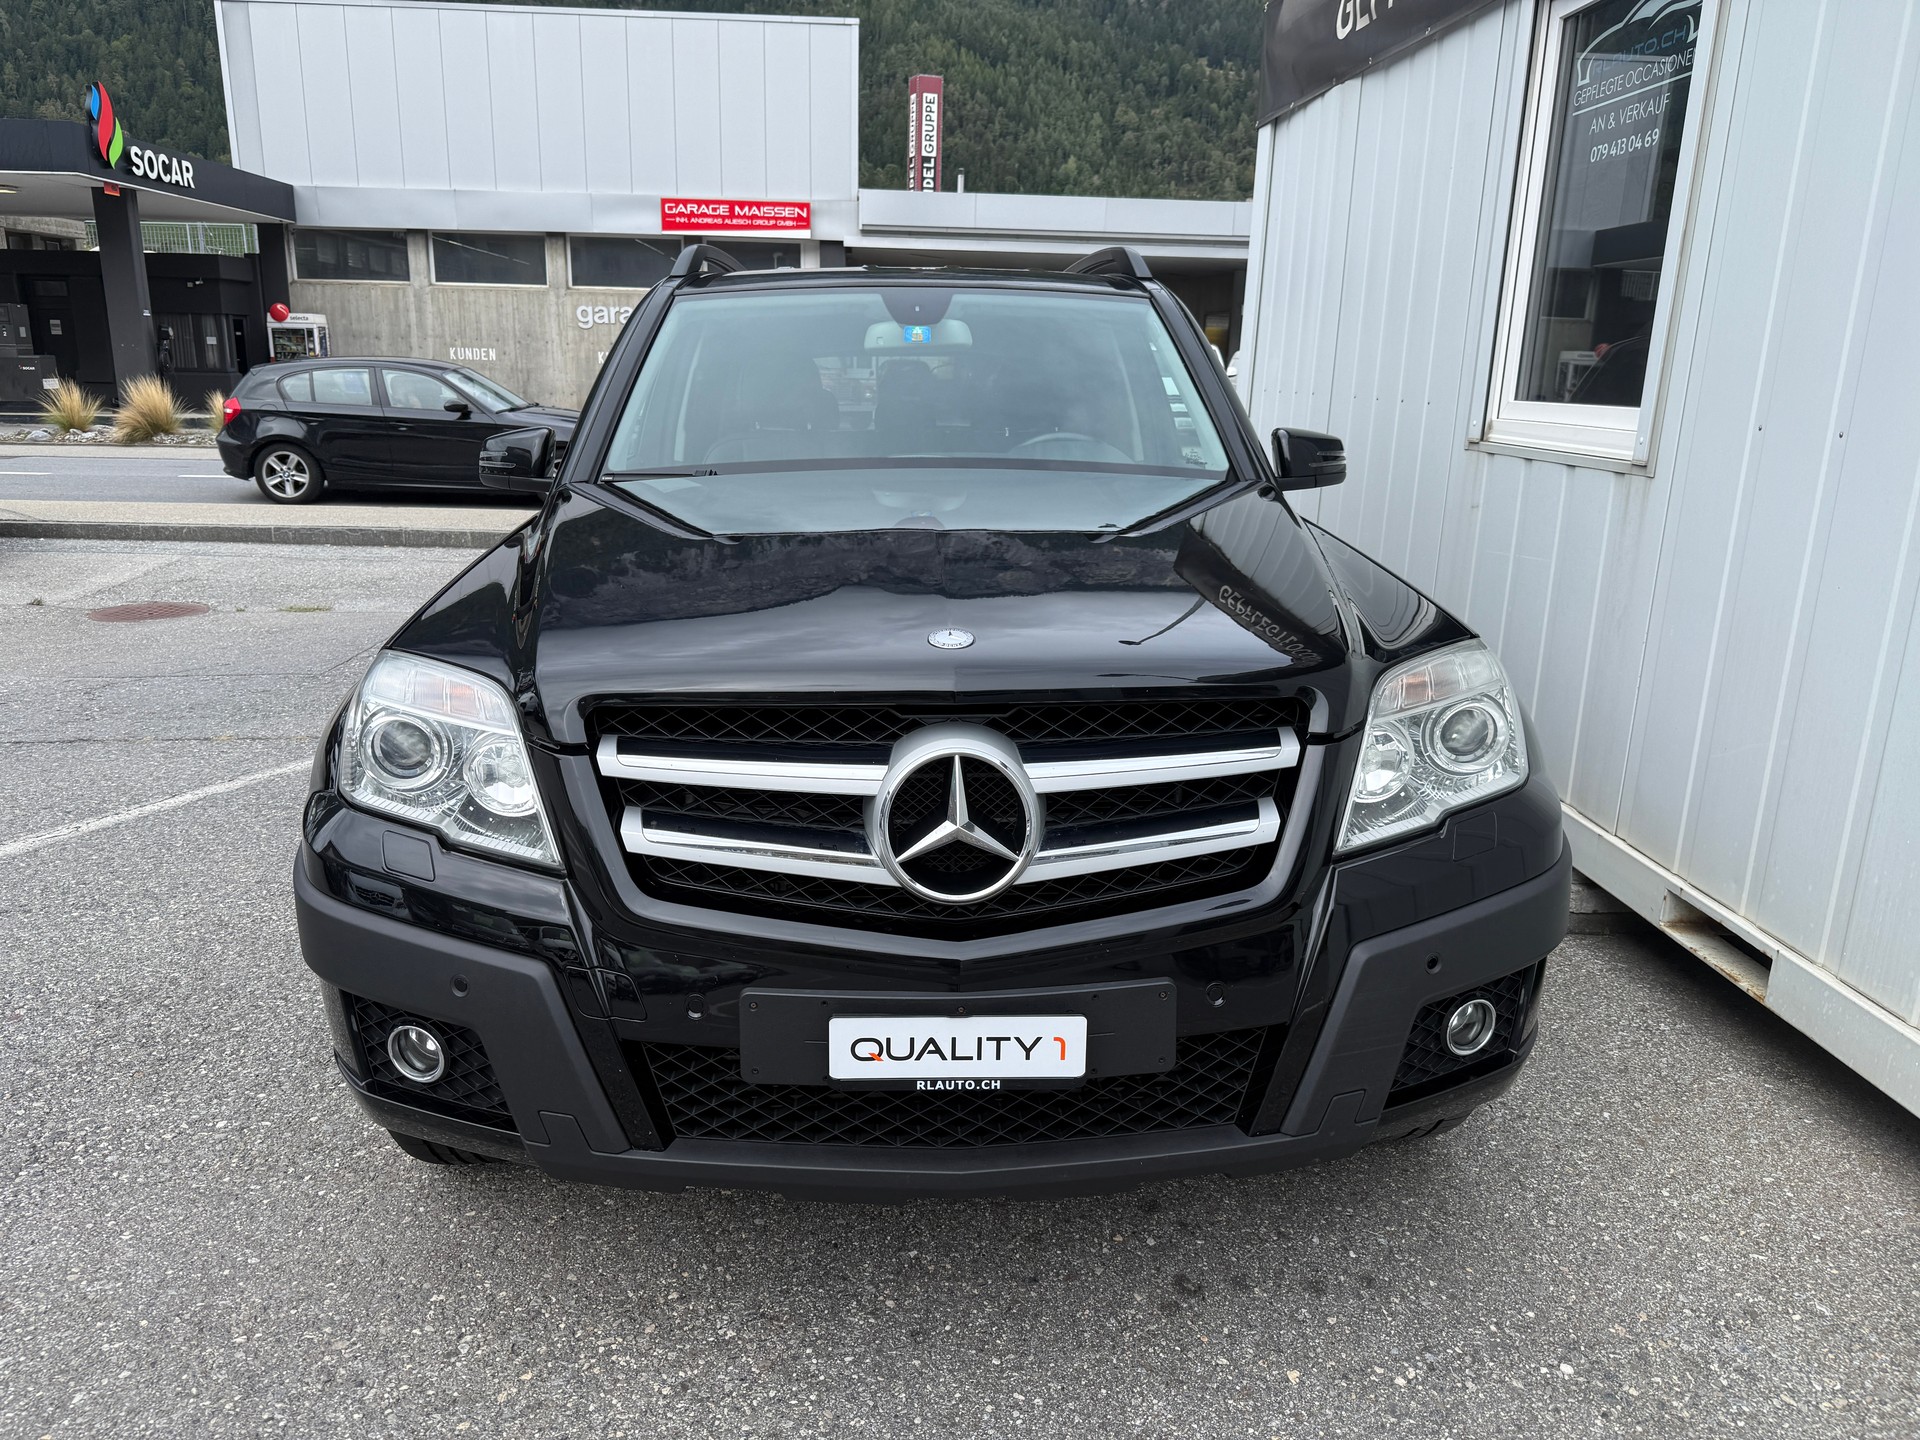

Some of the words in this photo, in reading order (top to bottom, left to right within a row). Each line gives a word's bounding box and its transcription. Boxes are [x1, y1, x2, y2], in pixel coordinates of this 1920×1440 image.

[1591, 24, 1687, 76] RLAUTO.CH
[1573, 74, 1624, 107] GEPFLEGTE
[924, 96, 935, 153] GRUPPE
[1589, 115, 1606, 135] AN
[1608, 113, 1616, 129] &
[1619, 93, 1671, 125] VERKAUF
[1590, 143, 1609, 163] 079
[1609, 138, 1627, 157] 413
[1628, 133, 1642, 152] 04
[1644, 128, 1659, 147] 69
[129, 145, 195, 189] SOCAR
[664, 203, 730, 216] GARAGE
[734, 205, 807, 218] MAISSEN
[690, 217, 723, 225] ANDREAS
[450, 347, 496, 361] KUNDEN
[850, 1036, 1043, 1062] QUALITY
[1053, 1036, 1066, 1061] 1
[916, 1079, 1001, 1091] RLAUTO.CH
